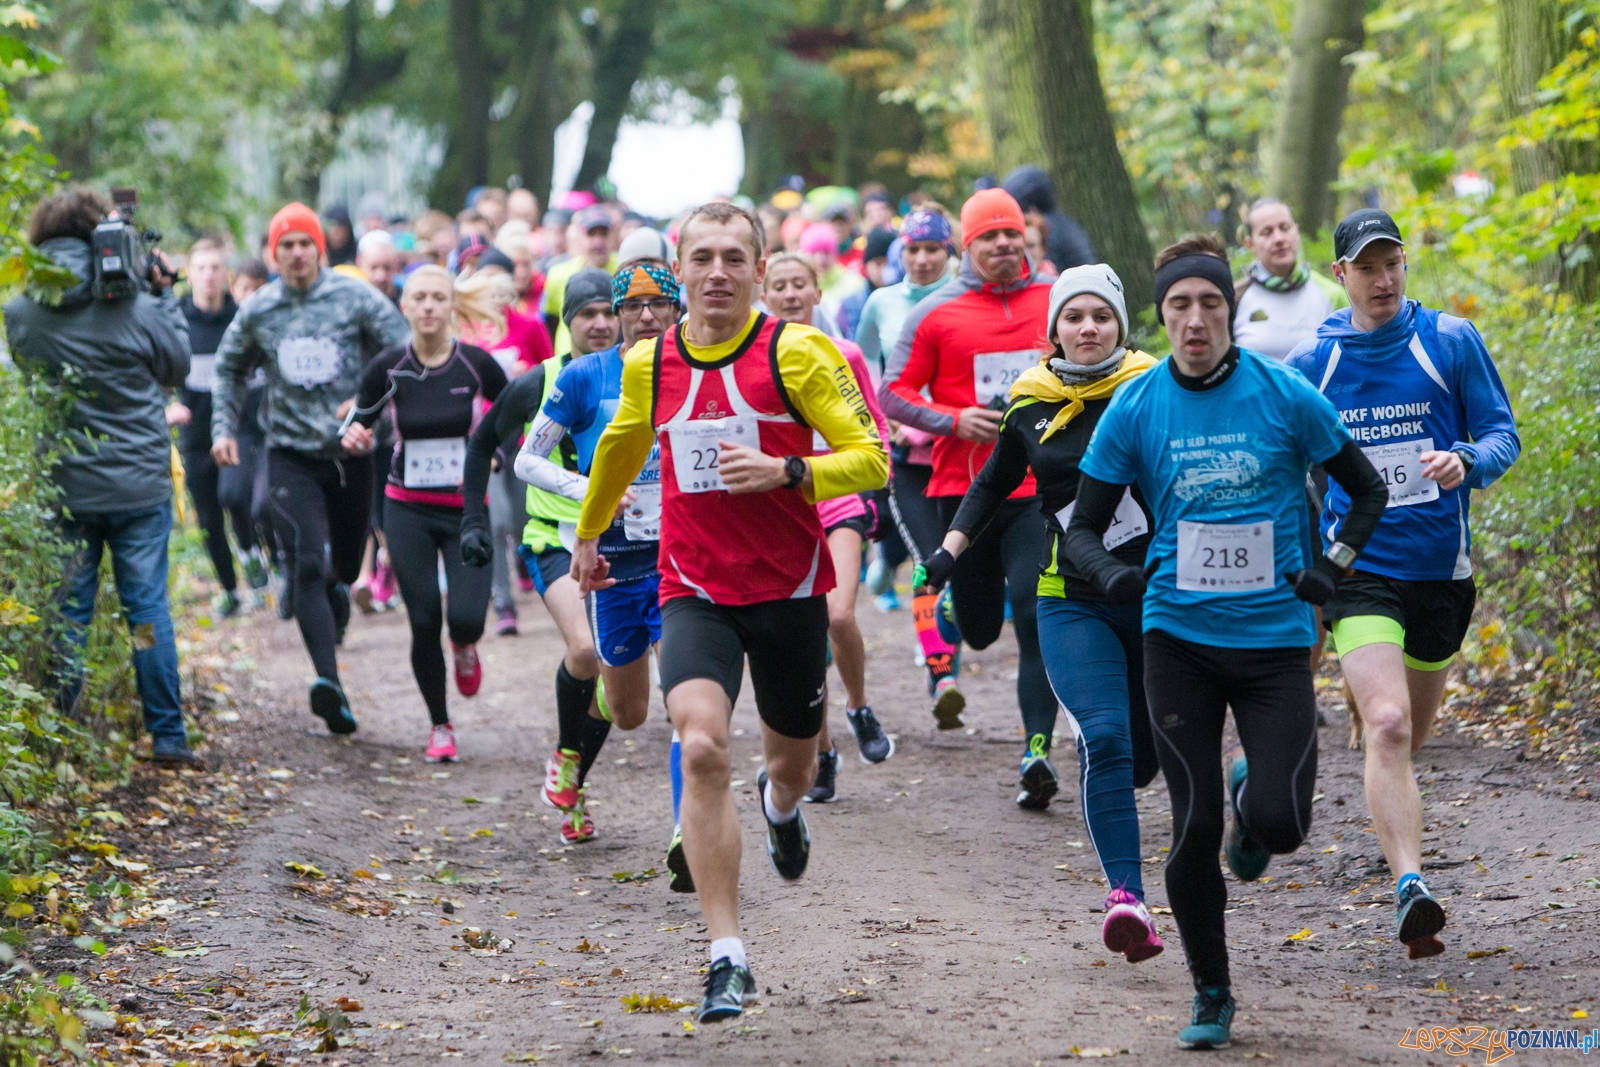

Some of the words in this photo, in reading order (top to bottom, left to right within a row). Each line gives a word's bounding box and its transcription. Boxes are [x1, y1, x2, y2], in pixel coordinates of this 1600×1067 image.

[1337, 408, 1368, 423] KKF
[1371, 402, 1432, 420] WODNIK
[425, 457, 444, 472] 25
[691, 447, 719, 471] 22
[640, 467, 660, 481] ŚRE
[1202, 547, 1249, 569] 218
